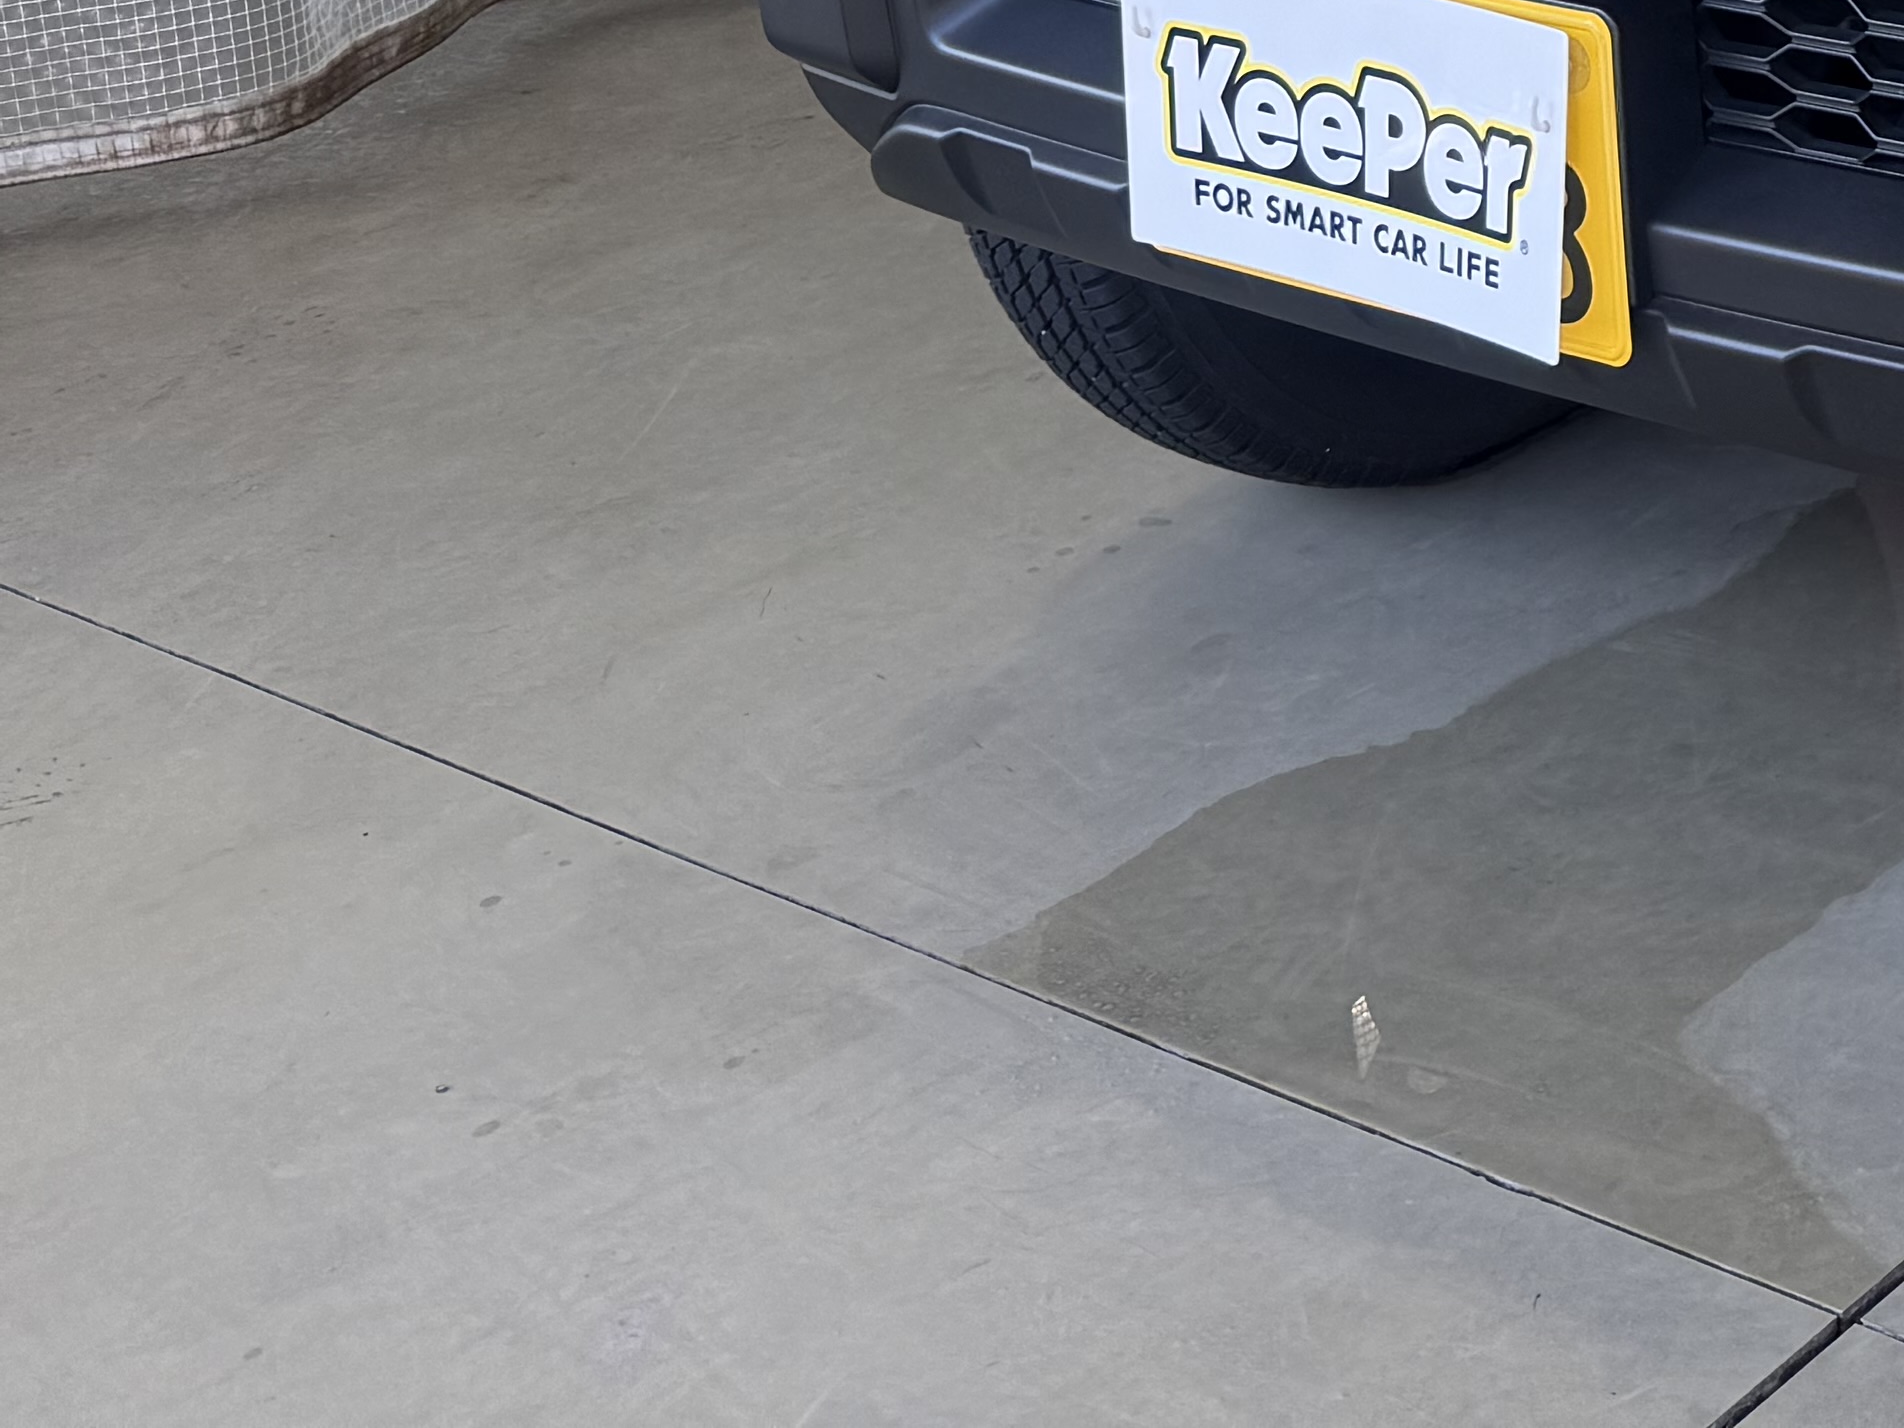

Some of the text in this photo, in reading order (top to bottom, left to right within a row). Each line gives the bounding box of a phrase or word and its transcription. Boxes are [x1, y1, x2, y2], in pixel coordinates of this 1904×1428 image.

[1166, 32, 1528, 236] KeePer
[1194, 178, 1499, 289] FOR SMART CAR LIFE
